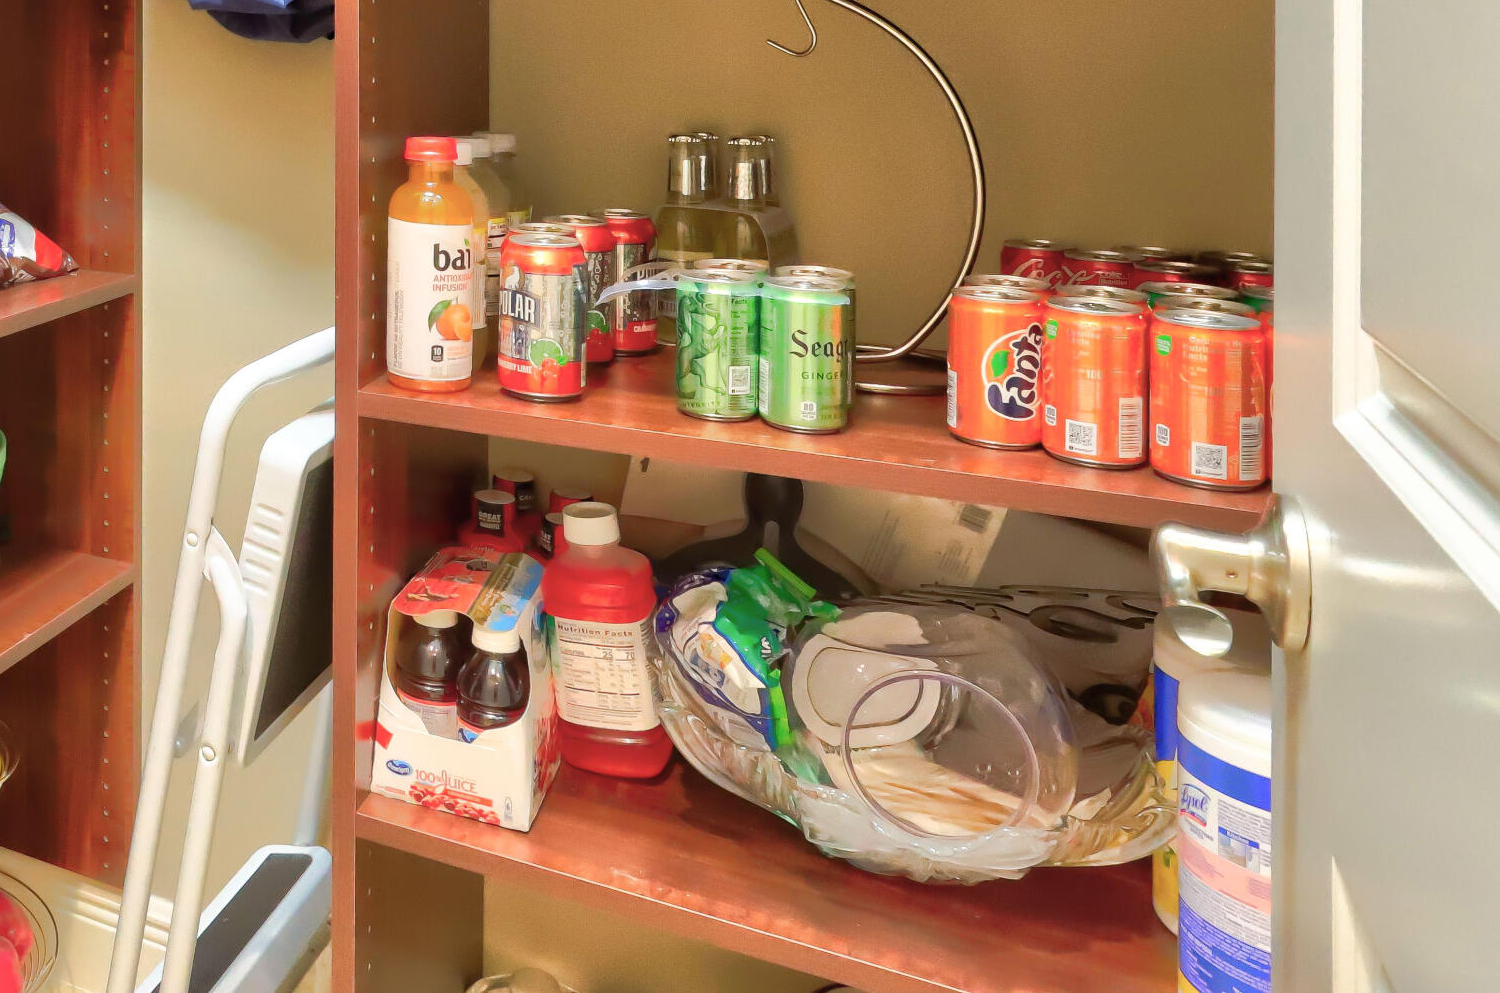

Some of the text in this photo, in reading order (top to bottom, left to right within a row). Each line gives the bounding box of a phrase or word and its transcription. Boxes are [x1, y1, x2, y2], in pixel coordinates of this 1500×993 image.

[433, 239, 471, 271] bai
[500, 289, 536, 323] OLAR
[432, 346, 442, 356] 10
[790, 330, 848, 362] Seag
[516, 364, 533, 374] LIME
[801, 371, 842, 381] GINGE
[987, 323, 1043, 420] Fanta
[478, 510, 502, 521] GREAT
[557, 624, 601, 636] Nutrition
[441, 769, 477, 794] JUICE
